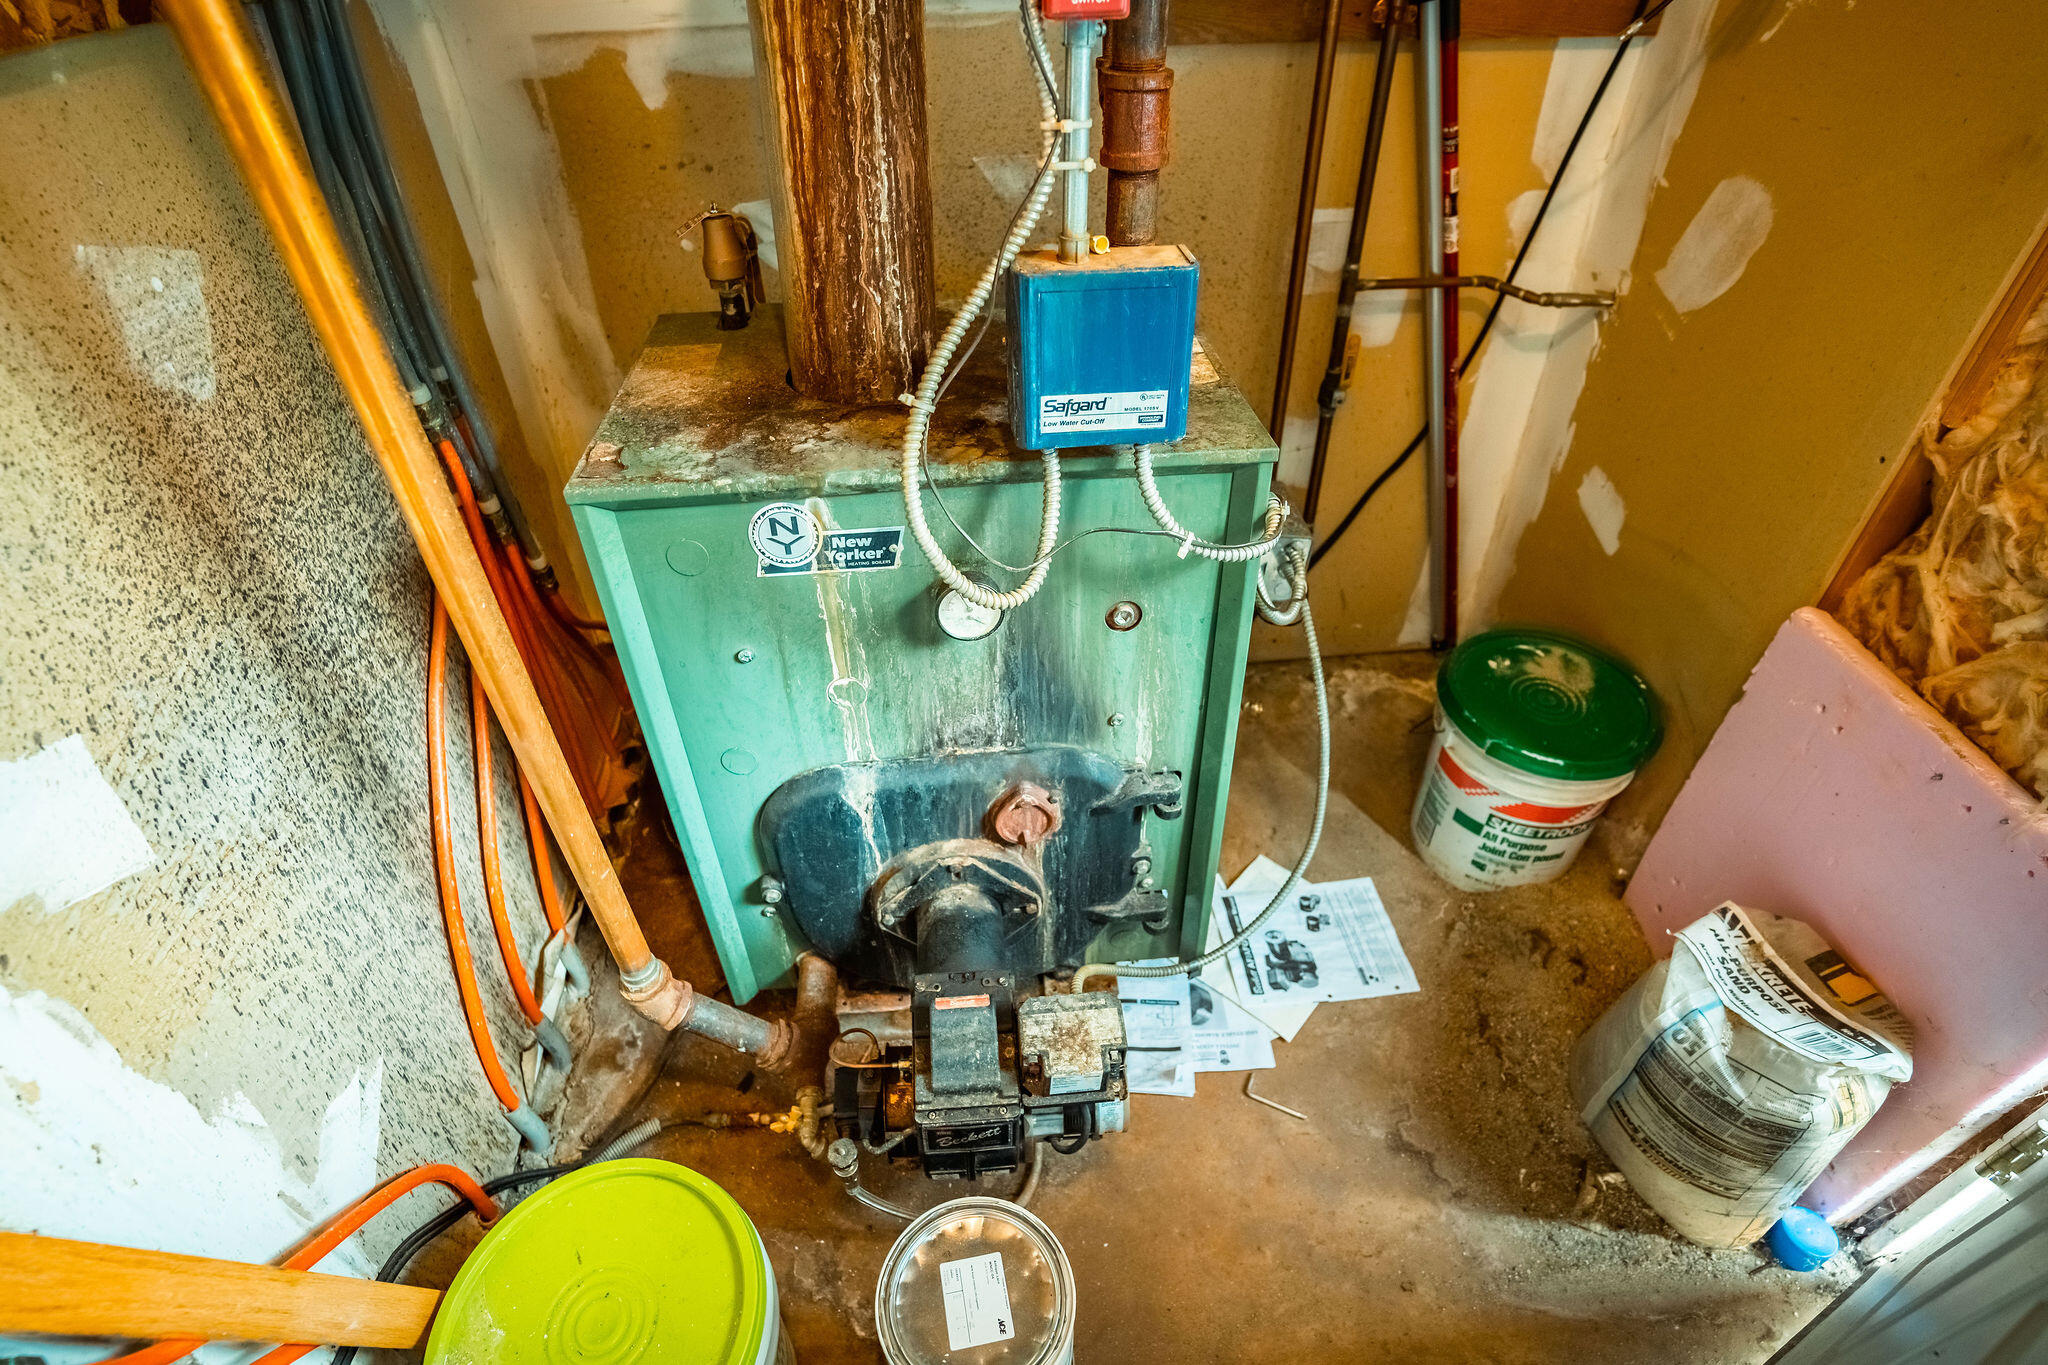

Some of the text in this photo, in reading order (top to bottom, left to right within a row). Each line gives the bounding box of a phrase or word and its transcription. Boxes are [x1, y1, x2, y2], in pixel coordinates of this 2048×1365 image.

[1043, 397, 1107, 416] Safgard
[1080, 418, 1105, 426] Cut-Off
[831, 537, 872, 549] New
[824, 549, 884, 562] Yorker
[1478, 842, 1507, 858] Joint
[1482, 831, 1547, 851] All Purpose
[1717, 957, 1750, 994] SAND
[1671, 1028, 1702, 1057] 50
[936, 1126, 1002, 1147] Beckett
[998, 1318, 1007, 1335] ACE
